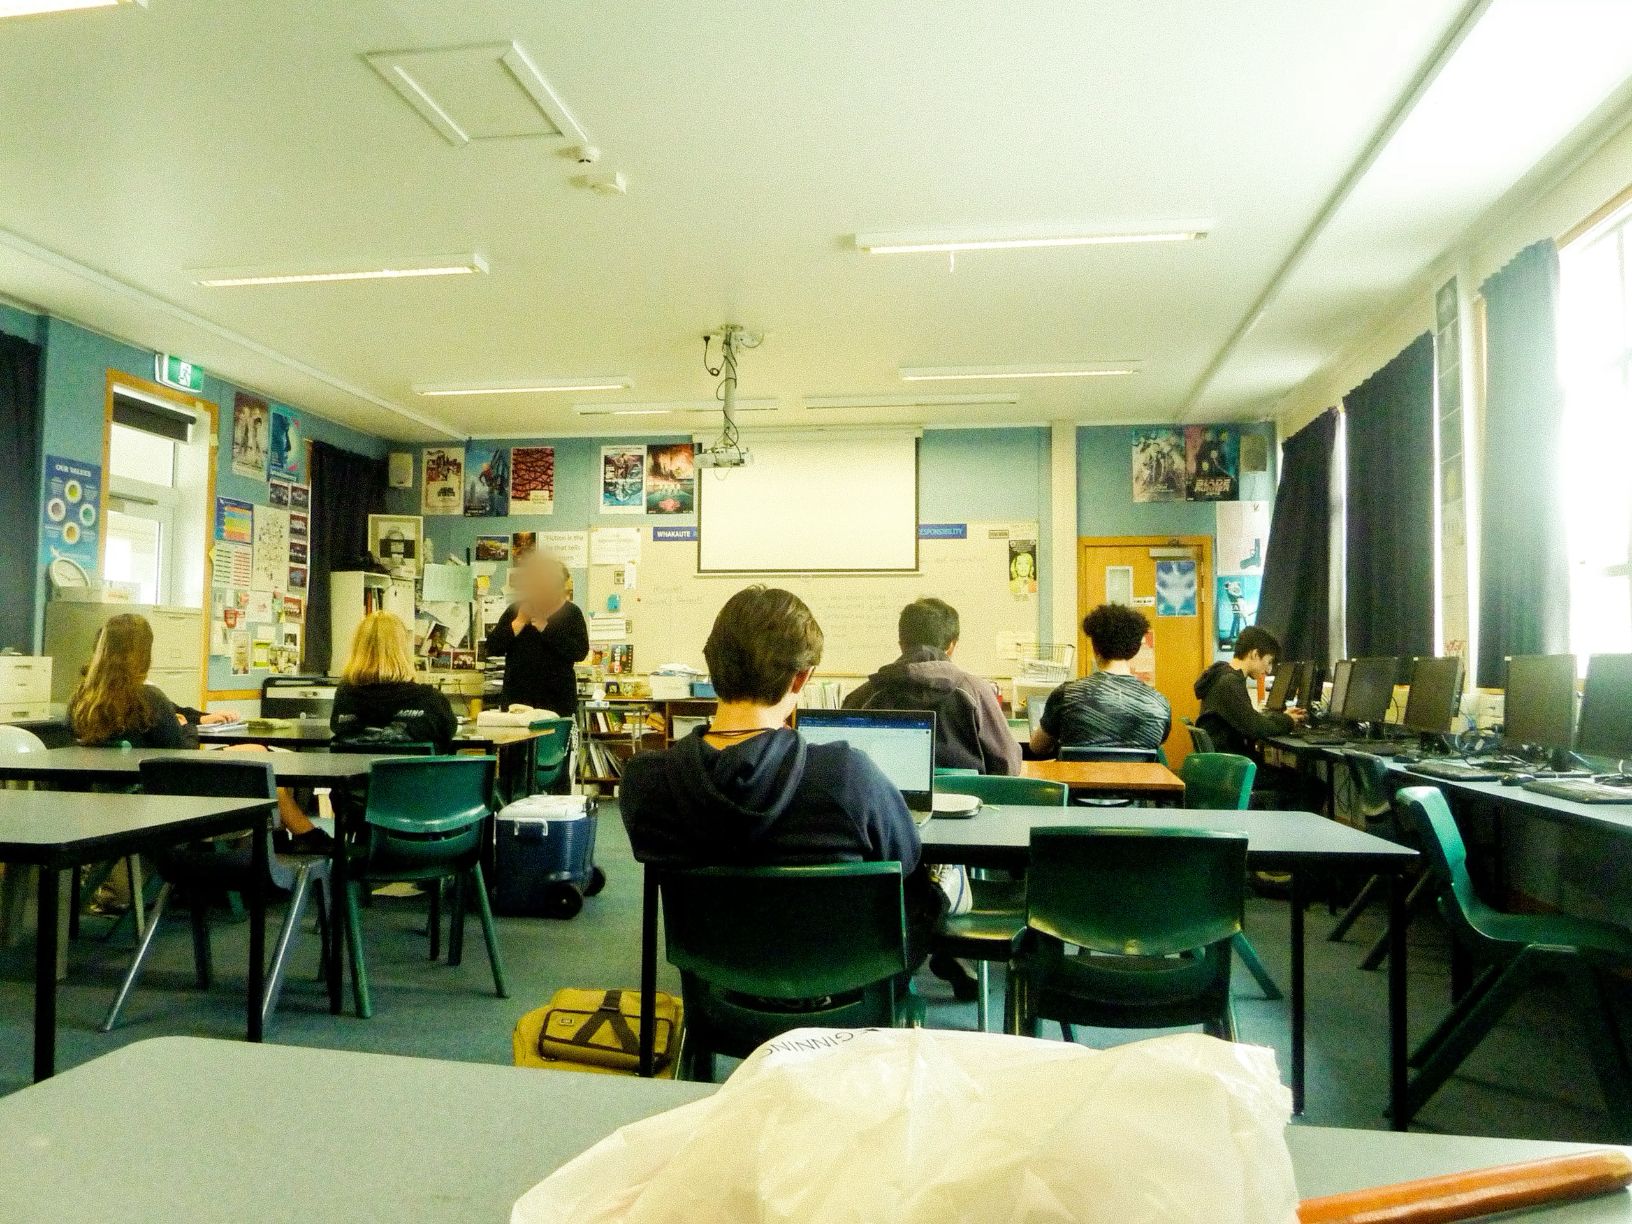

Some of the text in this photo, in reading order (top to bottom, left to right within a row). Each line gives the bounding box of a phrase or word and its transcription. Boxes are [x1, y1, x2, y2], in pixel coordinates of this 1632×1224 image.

[55, 464, 69, 473] OUR
[1196, 478, 1231, 486] BLADE
[656, 530, 690, 538] WHAKAUTE
[919, 527, 963, 536] ESPONSIBILITY
